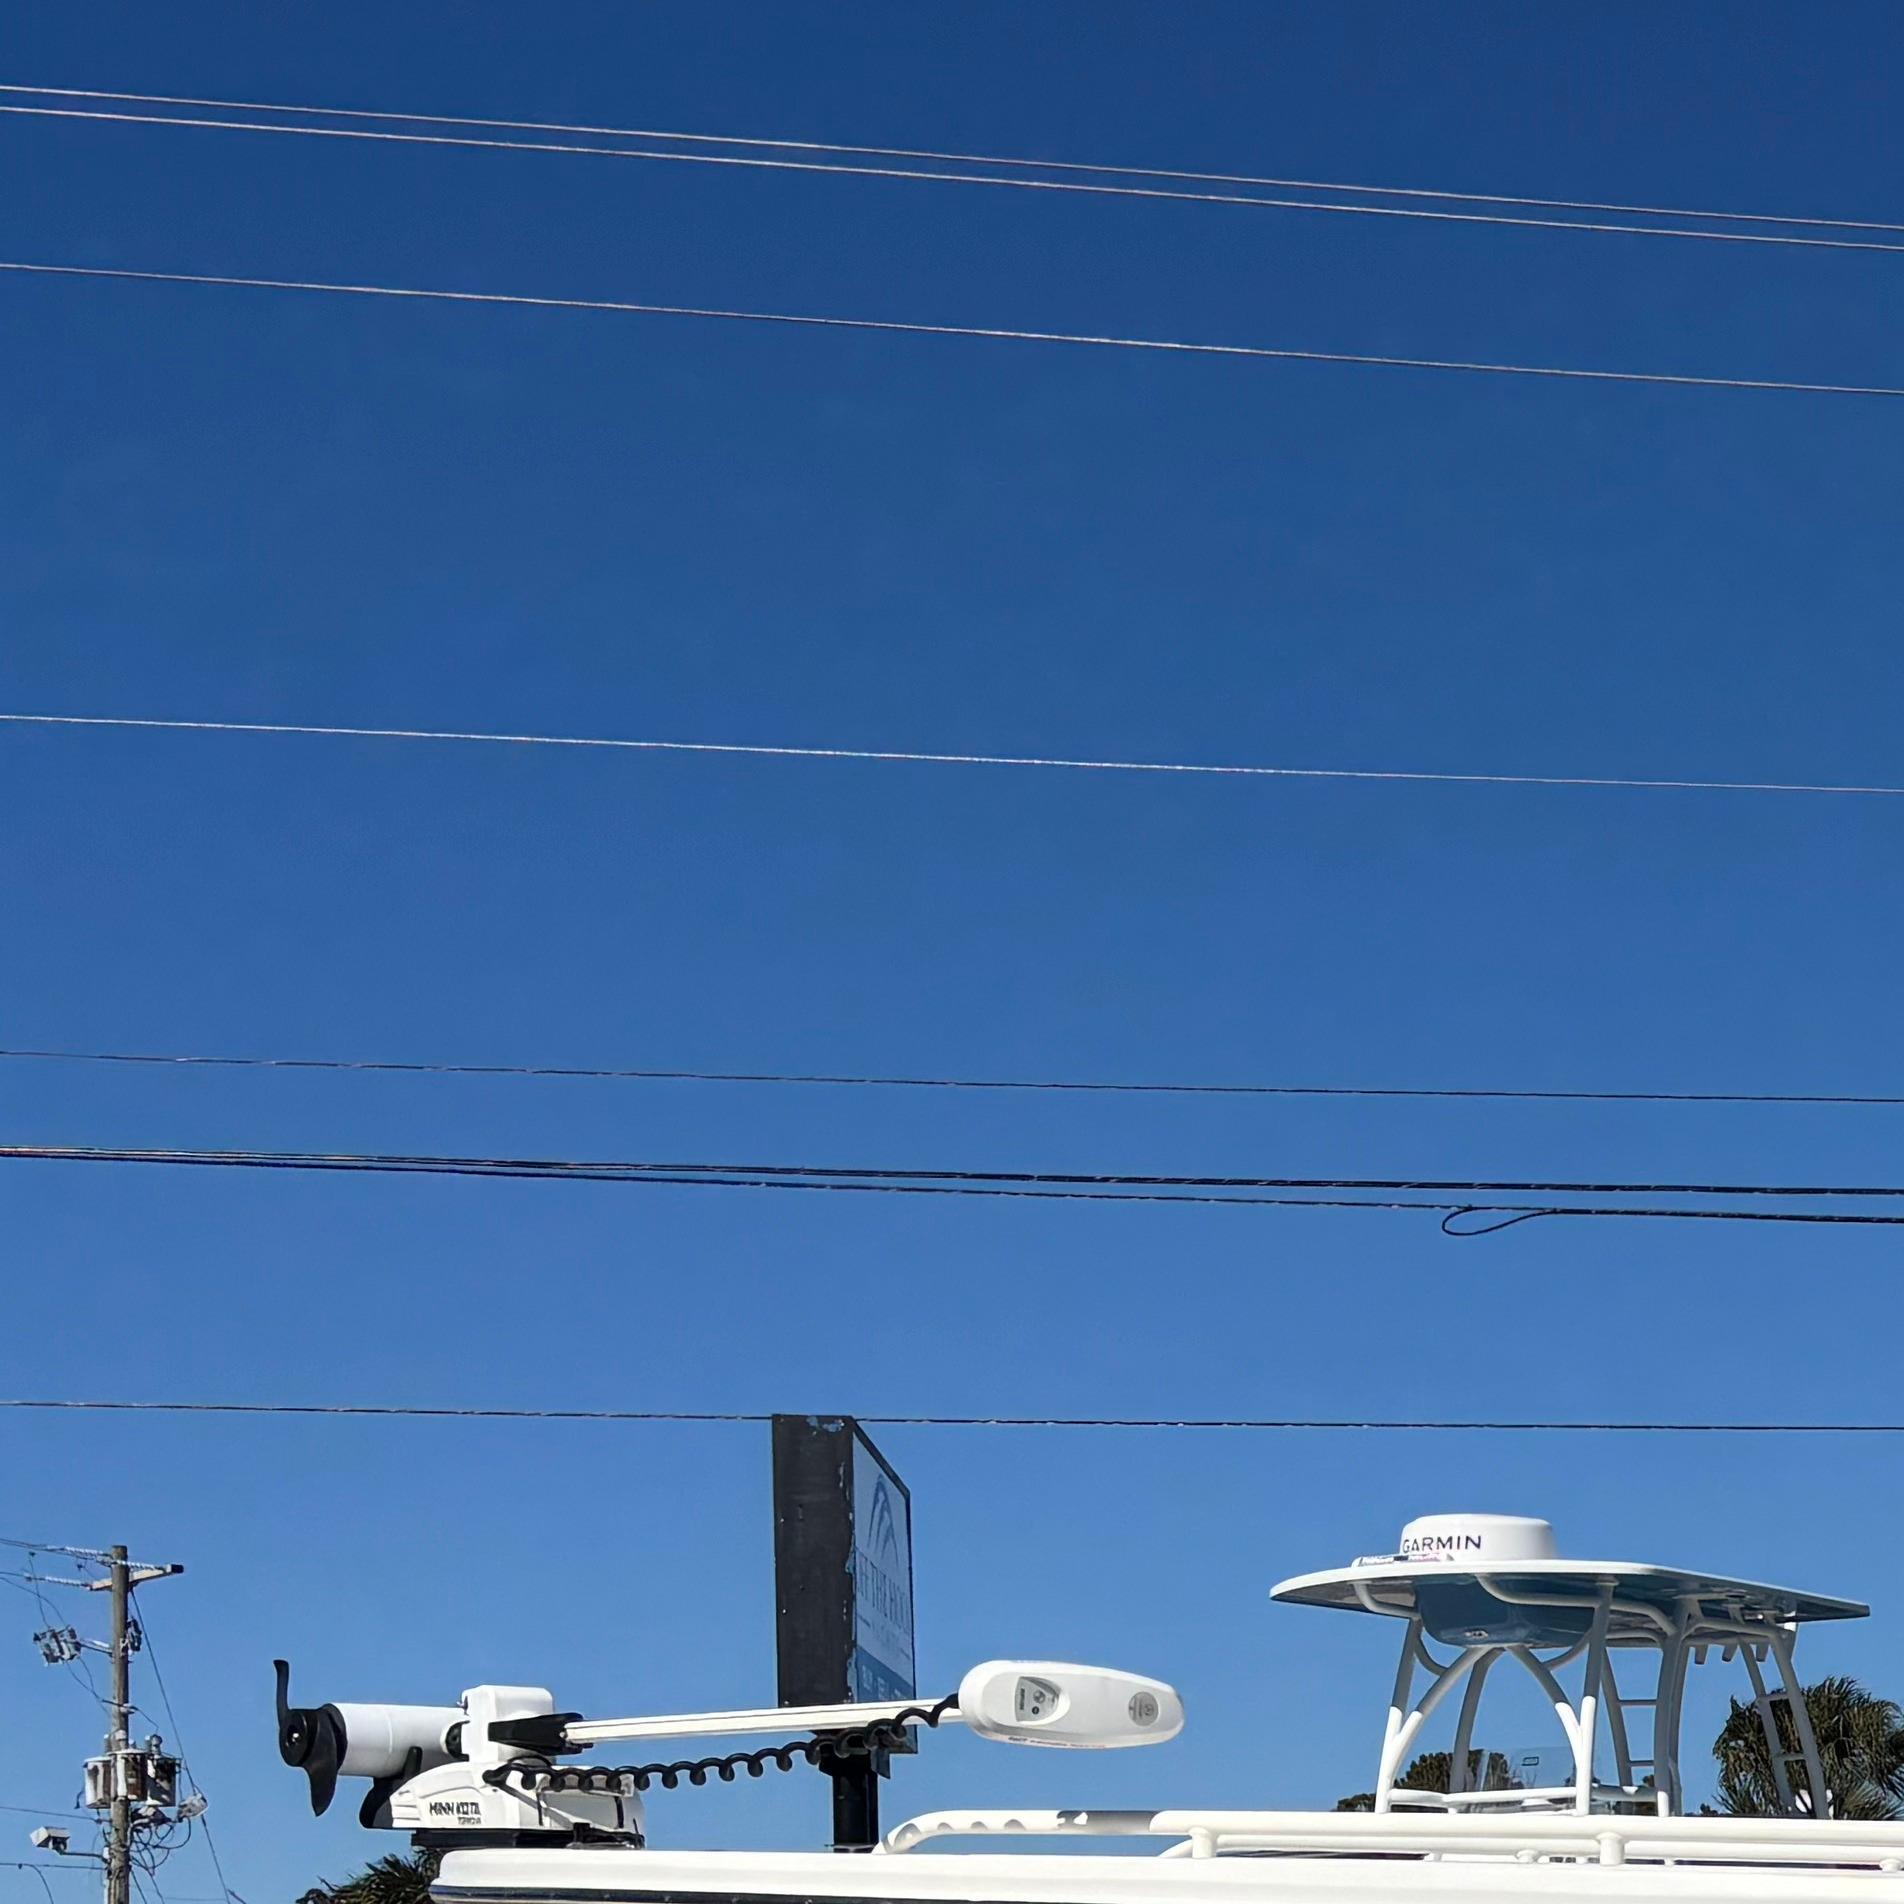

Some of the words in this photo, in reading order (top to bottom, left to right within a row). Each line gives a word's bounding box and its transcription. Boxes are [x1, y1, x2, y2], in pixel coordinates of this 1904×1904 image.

[1402, 1535, 1482, 1554] GARMIN
[429, 1801, 455, 1817] MINN
[456, 1801, 482, 1816] KOTA
